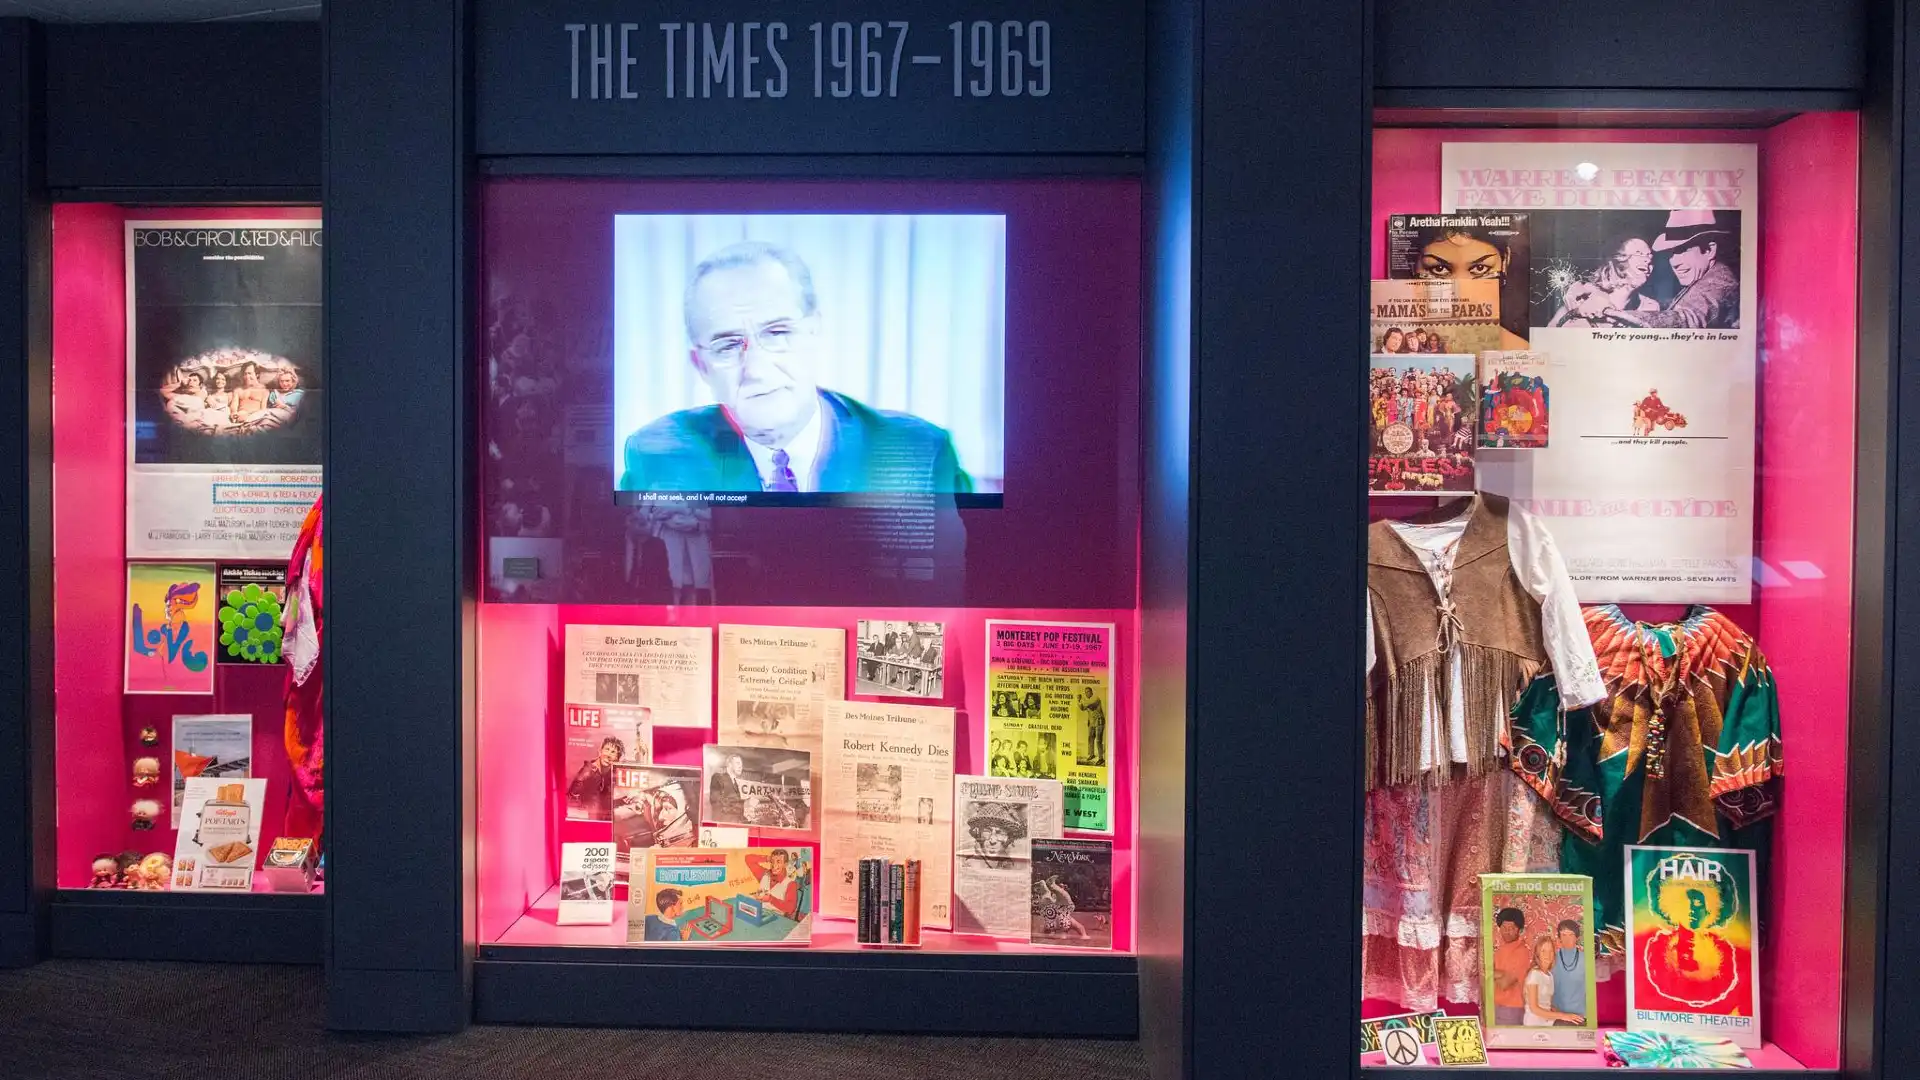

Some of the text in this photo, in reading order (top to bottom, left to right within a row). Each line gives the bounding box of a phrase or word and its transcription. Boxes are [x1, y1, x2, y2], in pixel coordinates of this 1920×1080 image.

[564, 23, 639, 99] THE
[660, 22, 788, 98] TIMES
[1612, 168, 1745, 188] BEATTY
[1455, 188, 1740, 208] FAYE DUNAWAY
[1410, 216, 1510, 227] Aretha Franklin Yeah!!!
[1376, 304, 1426, 318] MAMA'S
[1451, 304, 1493, 318] PAPA'S
[1592, 332, 1738, 342] They're young... they're in love
[643, 493, 657, 501] shall
[686, 493, 699, 501] and
[704, 493, 715, 501] will
[727, 494, 747, 502] accept
[1630, 497, 1738, 518] CLYDE
[605, 636, 677, 647] The New York Times
[753, 638, 778, 646] Moines
[780, 639, 808, 647] Tribune
[997, 630, 1102, 643] MONTEREY POP FESTIVAL
[738, 664, 807, 675] Kennedy Condition
[570, 708, 599, 727] LIFE
[859, 713, 884, 721] Moines
[886, 714, 917, 723] Tribune
[843, 739, 949, 756] Robert Kennedy Dies
[618, 769, 649, 787] LIFE
[1074, 809, 1098, 818] WEST
[585, 848, 609, 856] 2001
[660, 869, 722, 881] BATTLESHIP
[1660, 858, 1721, 882] HAIR
[1492, 880, 1585, 892] the mod squad
[1637, 1010, 1750, 1027] BILTMORE THEATER
